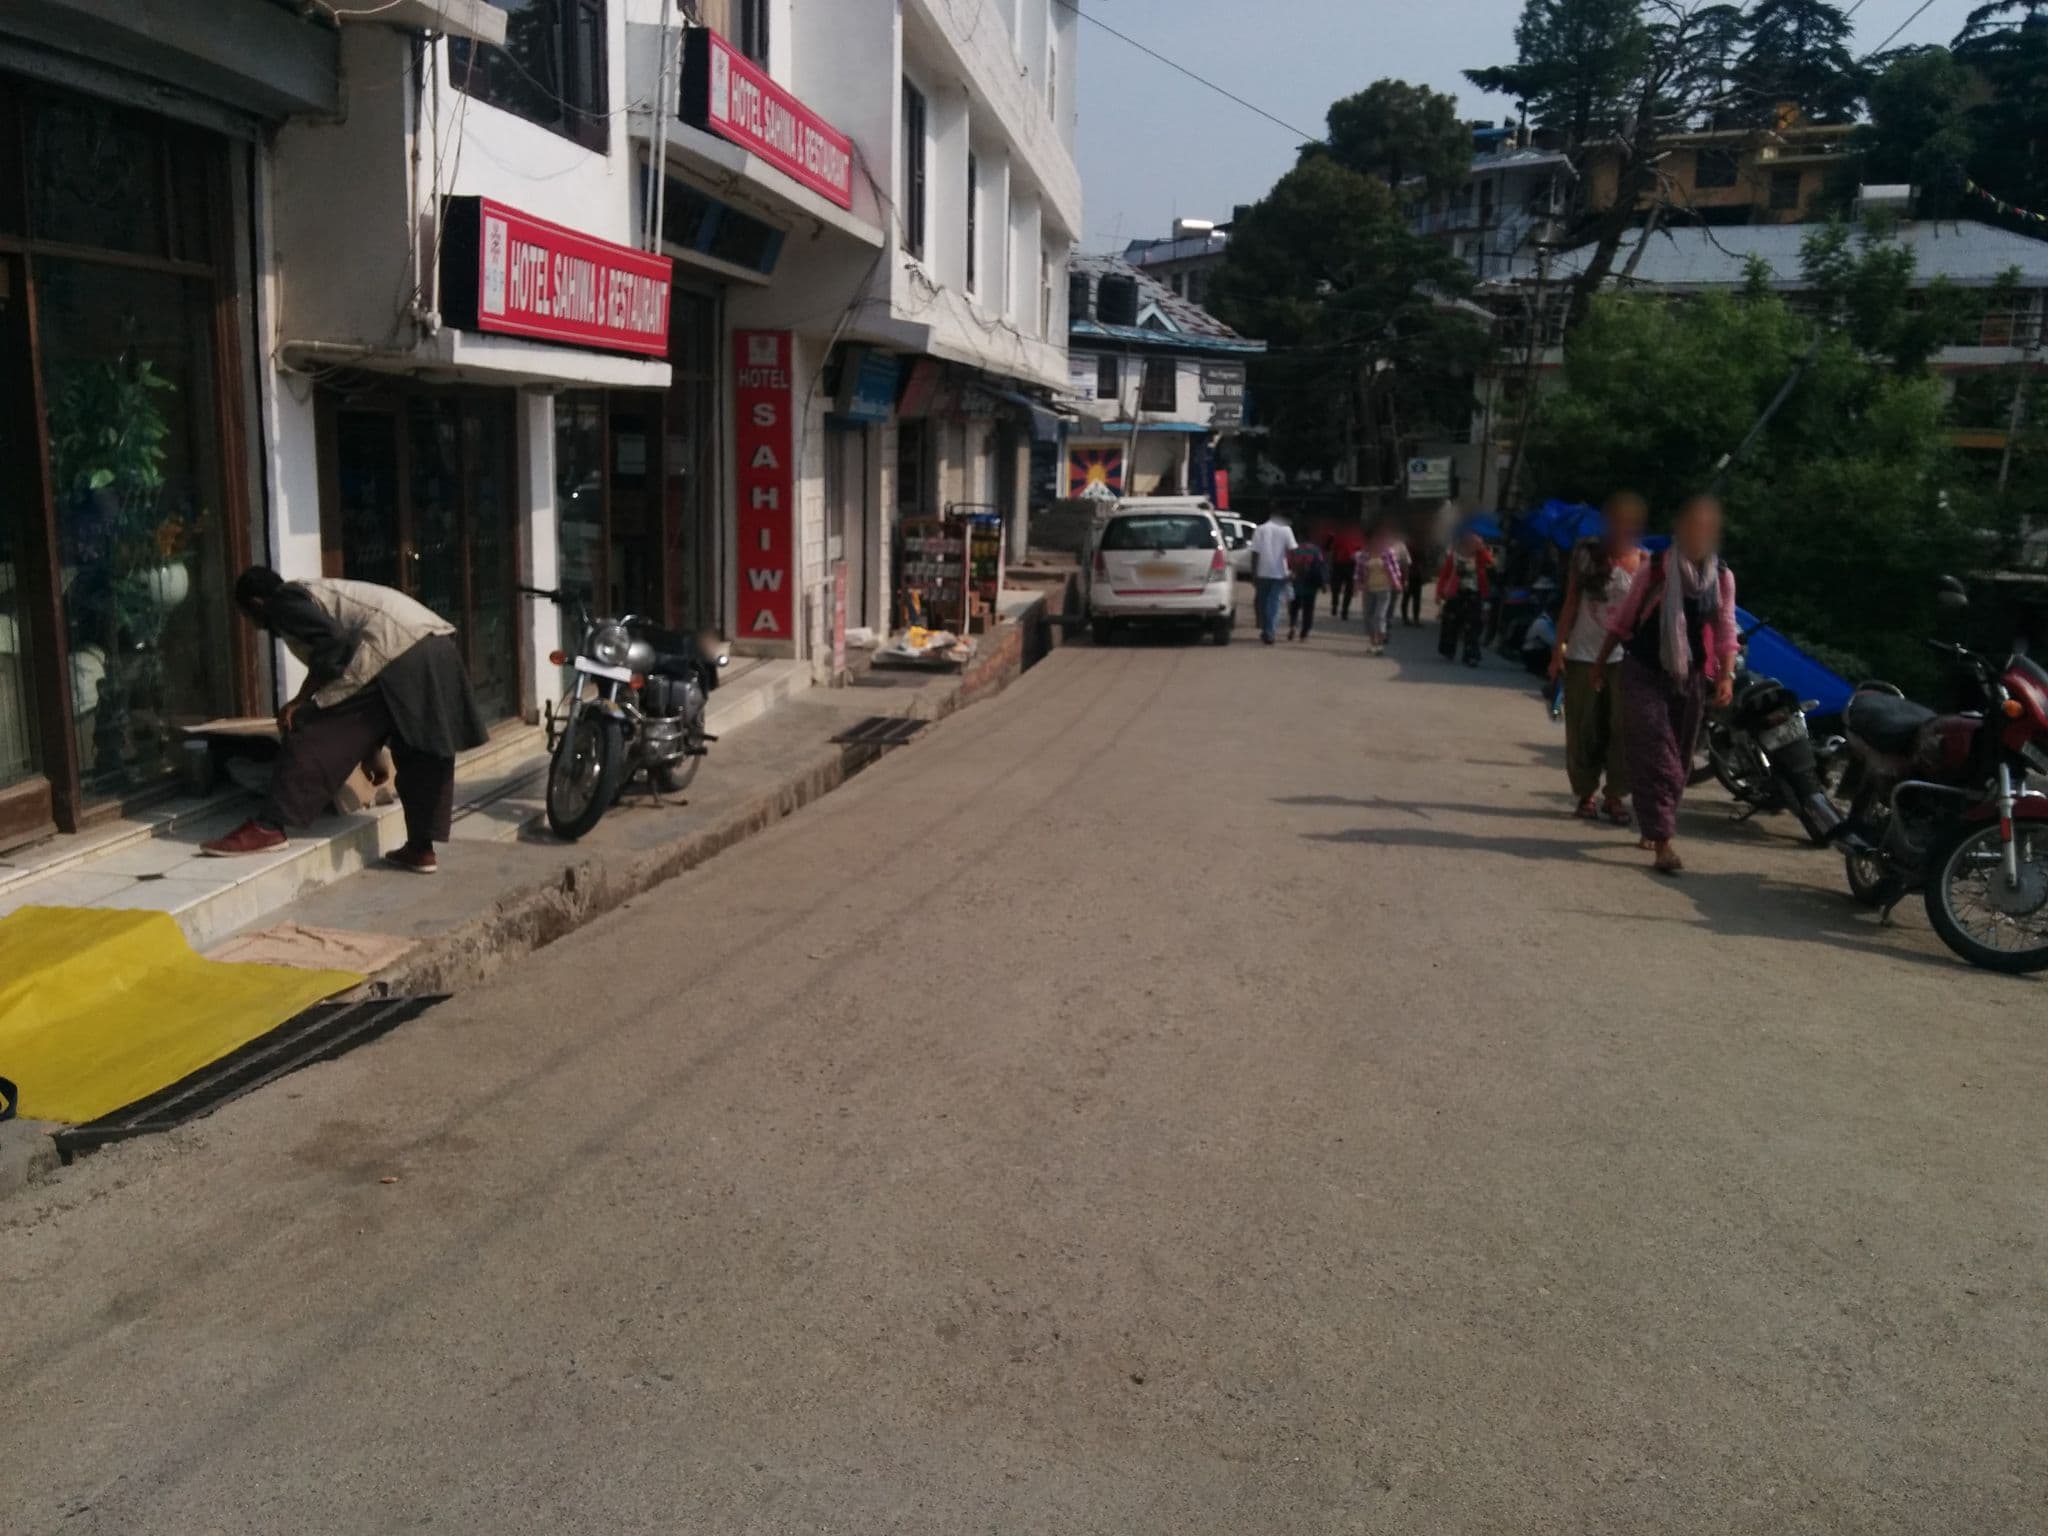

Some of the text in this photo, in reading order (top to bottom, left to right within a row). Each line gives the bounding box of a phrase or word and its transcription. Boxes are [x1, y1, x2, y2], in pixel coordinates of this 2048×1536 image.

[731, 70, 763, 139] HOTEL
[798, 120, 804, 164] &
[804, 126, 850, 193] RESTAURANT
[509, 239, 550, 315] HOTEL
[598, 265, 606, 326] &
[607, 268, 668, 335] RESTAURANT
[738, 367, 789, 389] HOTEL
[749, 403, 783, 632] SAHIWA
